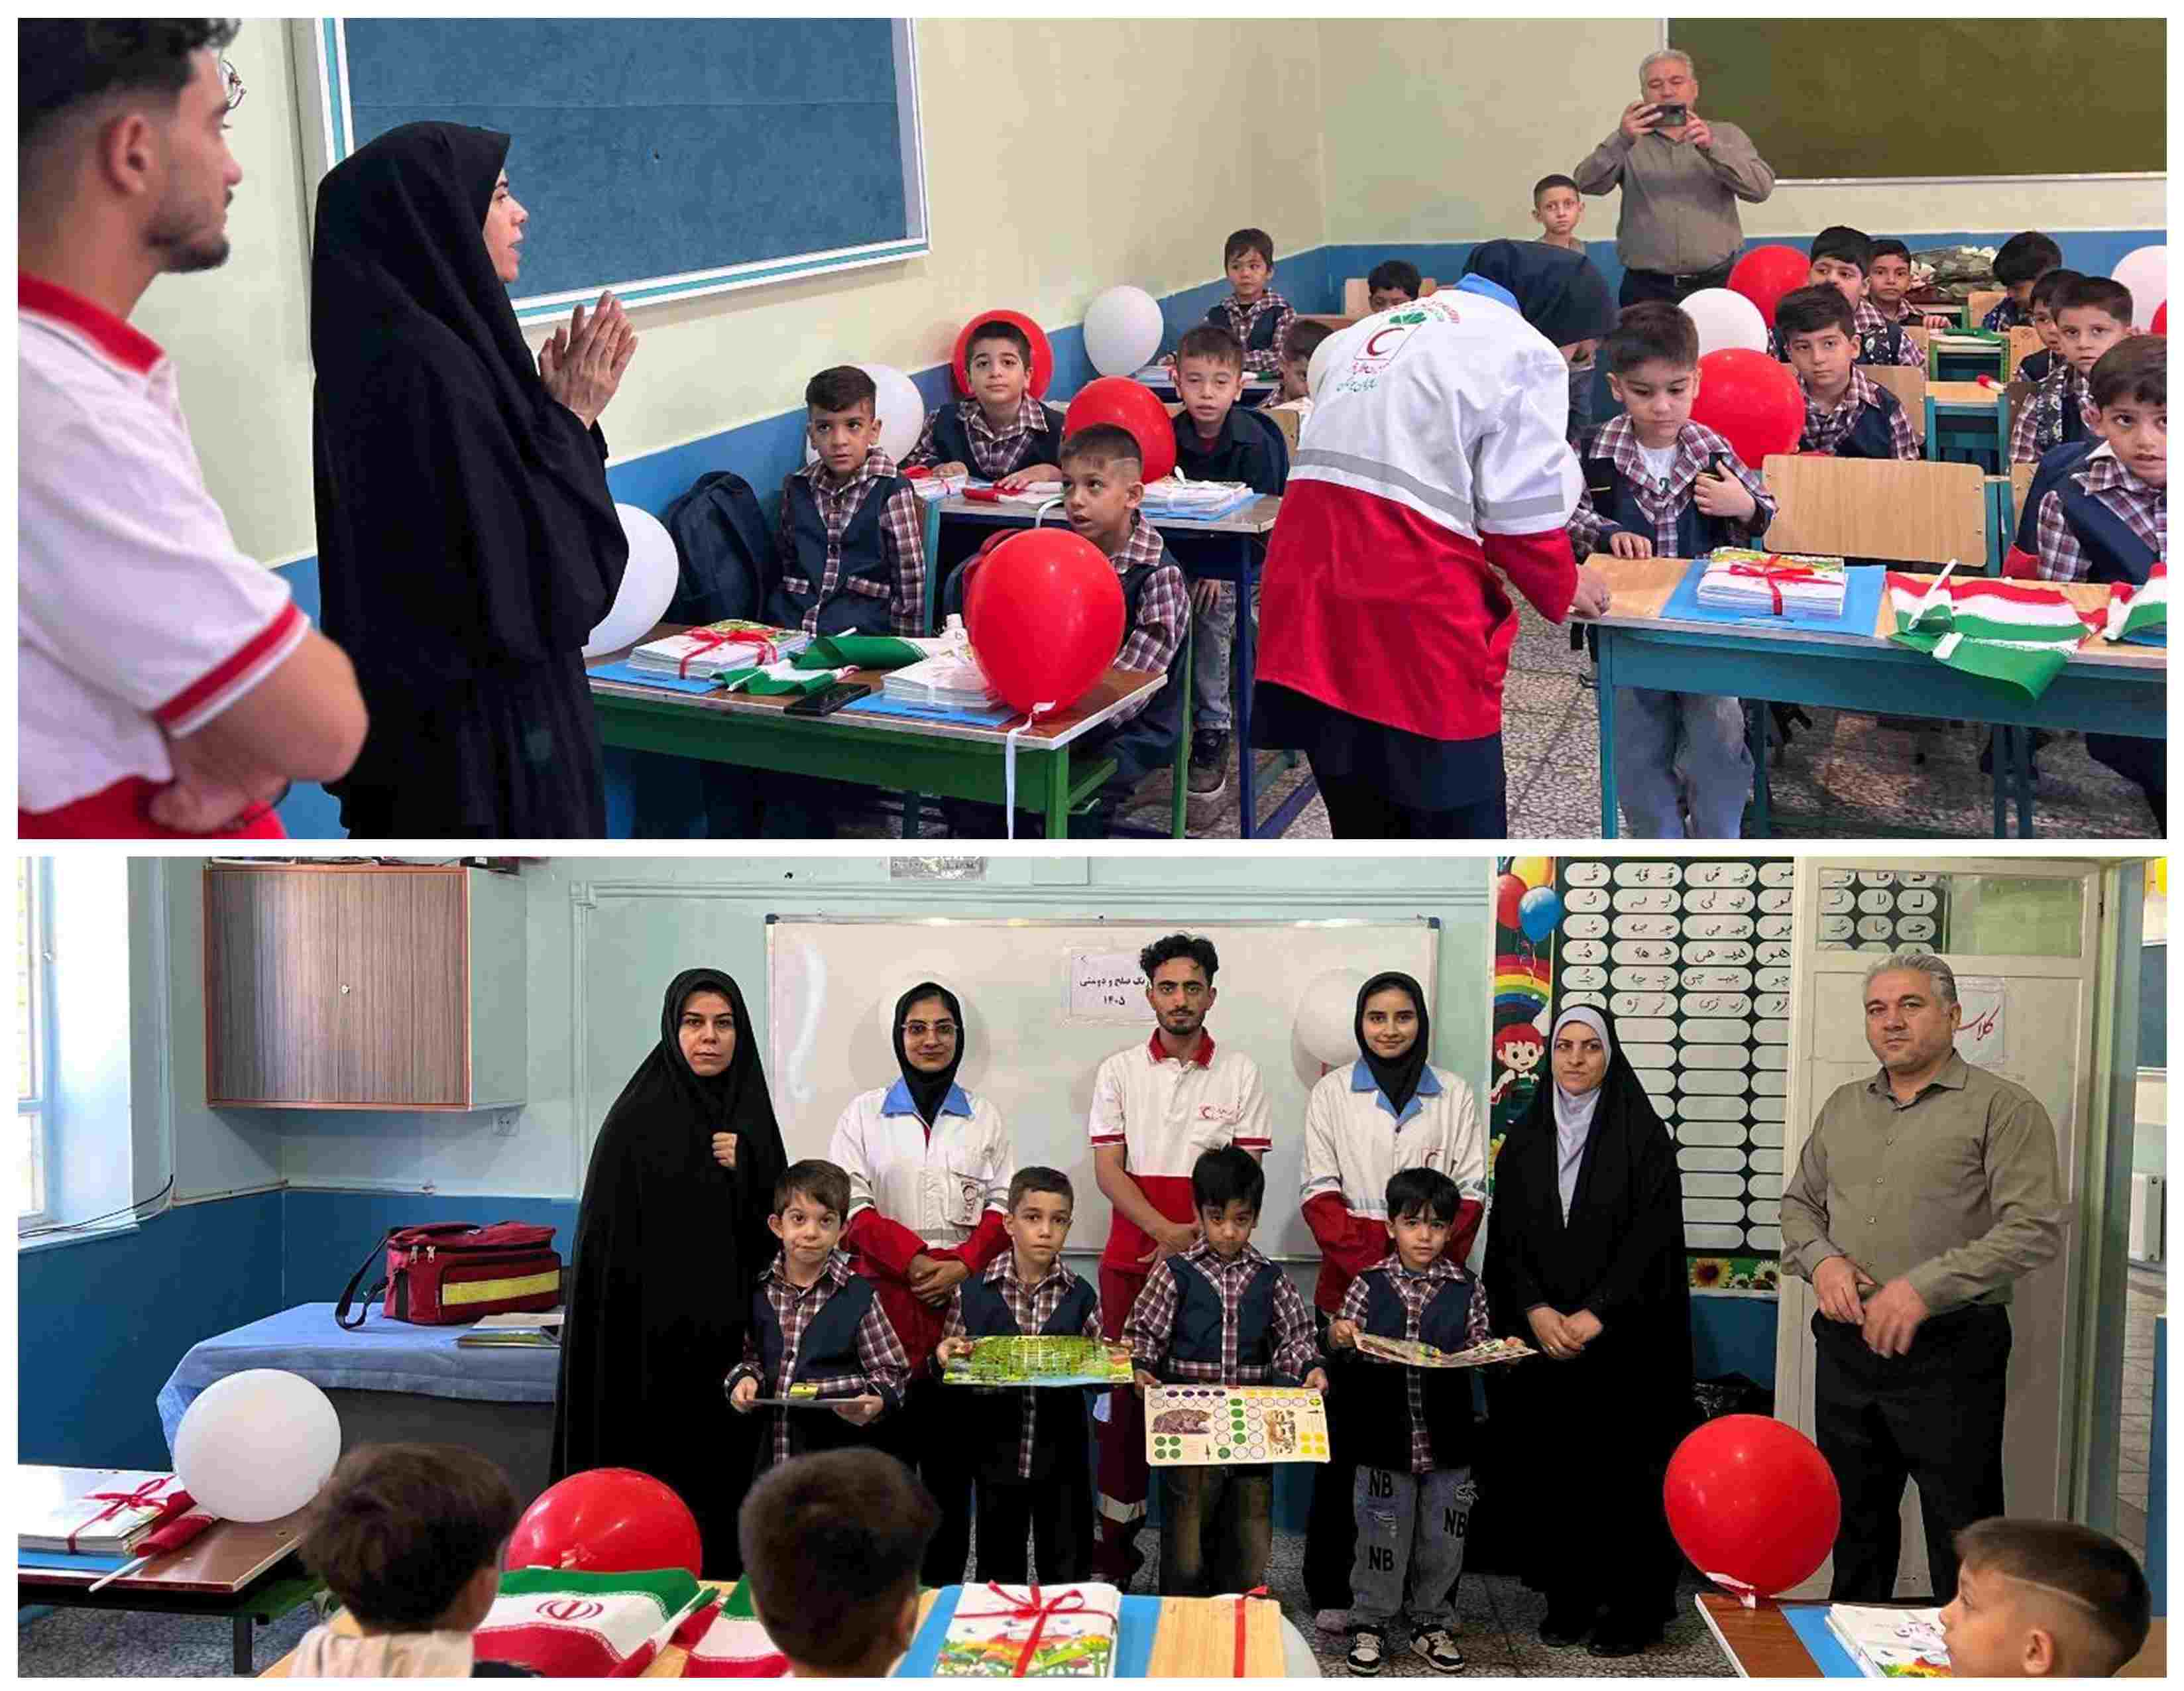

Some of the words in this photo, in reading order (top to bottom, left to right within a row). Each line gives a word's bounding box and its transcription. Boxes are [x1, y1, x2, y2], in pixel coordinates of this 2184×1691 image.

[1079, 976, 1106, 987] دوستی
[1114, 976, 1131, 987] صلح
[1369, 1468, 1393, 1498] NB
[1443, 1506, 1467, 1539] NB
[1368, 1545, 1395, 1572] NB
